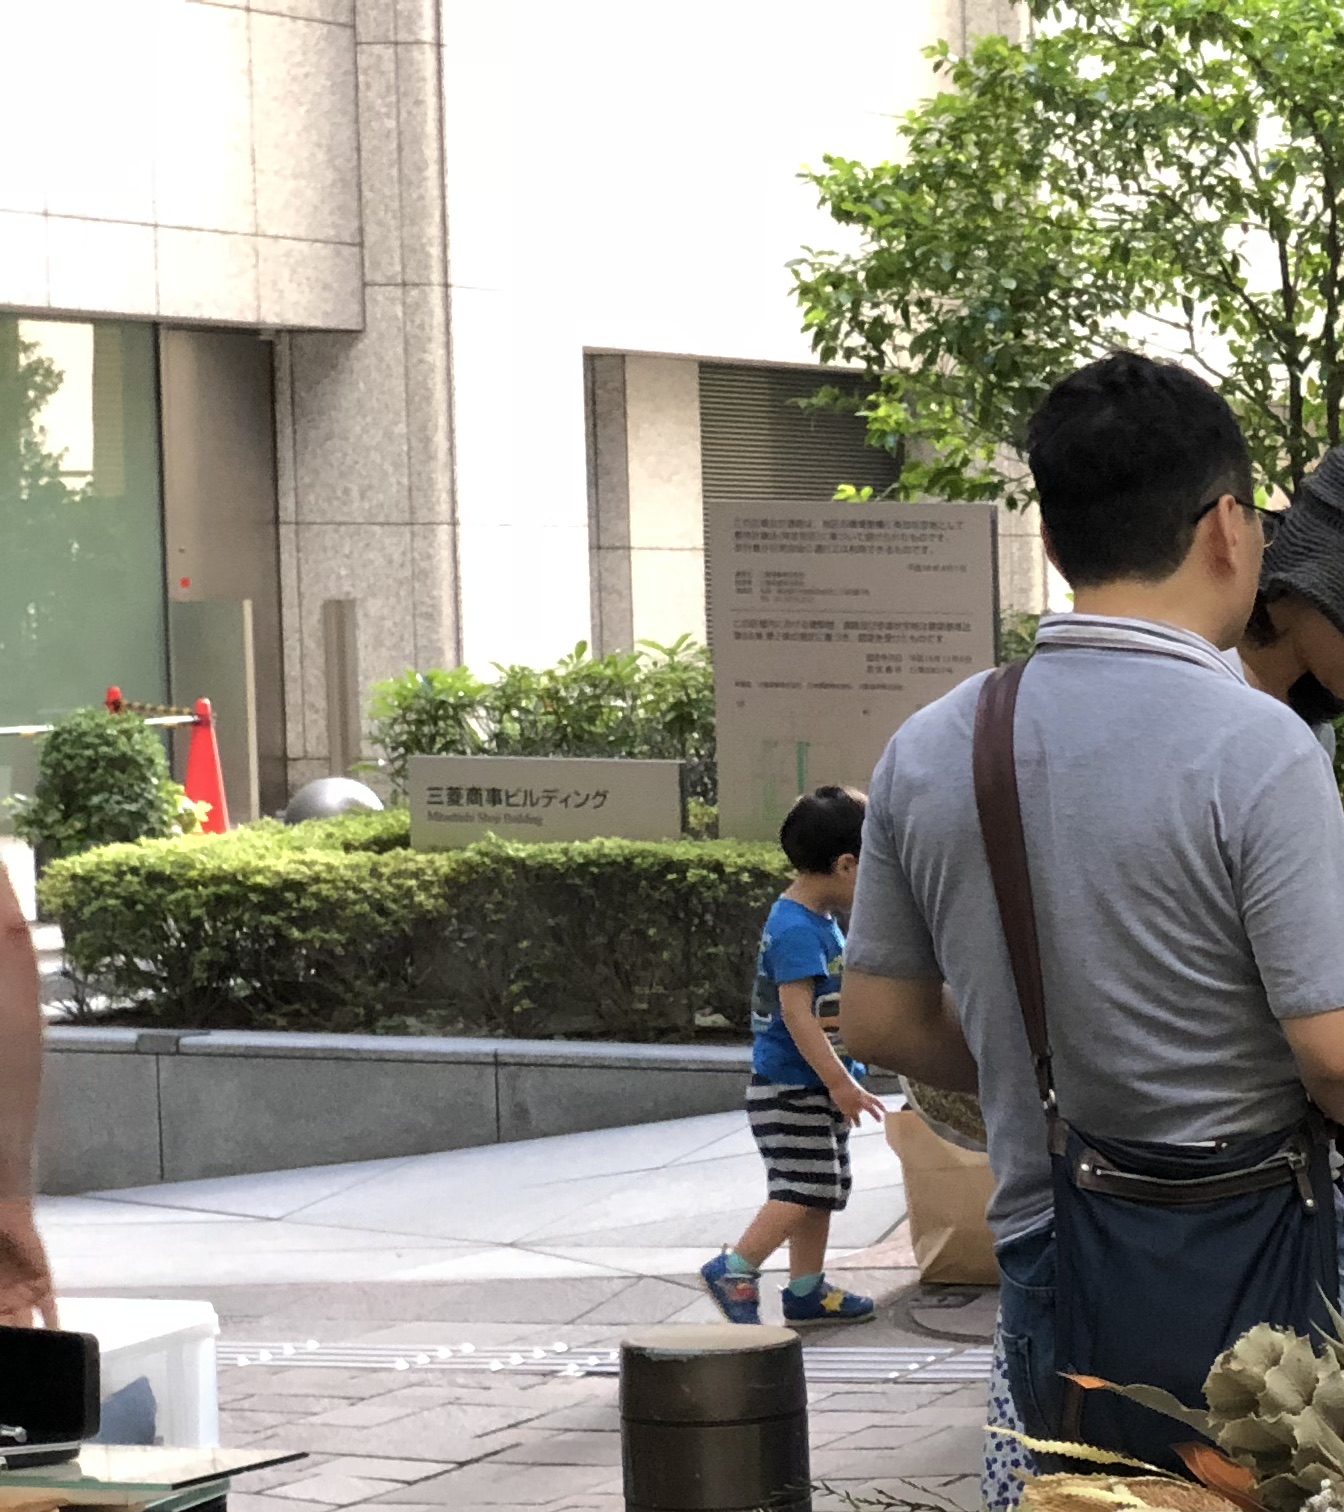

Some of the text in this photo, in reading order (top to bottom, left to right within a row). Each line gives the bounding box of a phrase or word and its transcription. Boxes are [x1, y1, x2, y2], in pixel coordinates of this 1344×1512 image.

[427, 786, 609, 809] 三菱商事ビルディング
